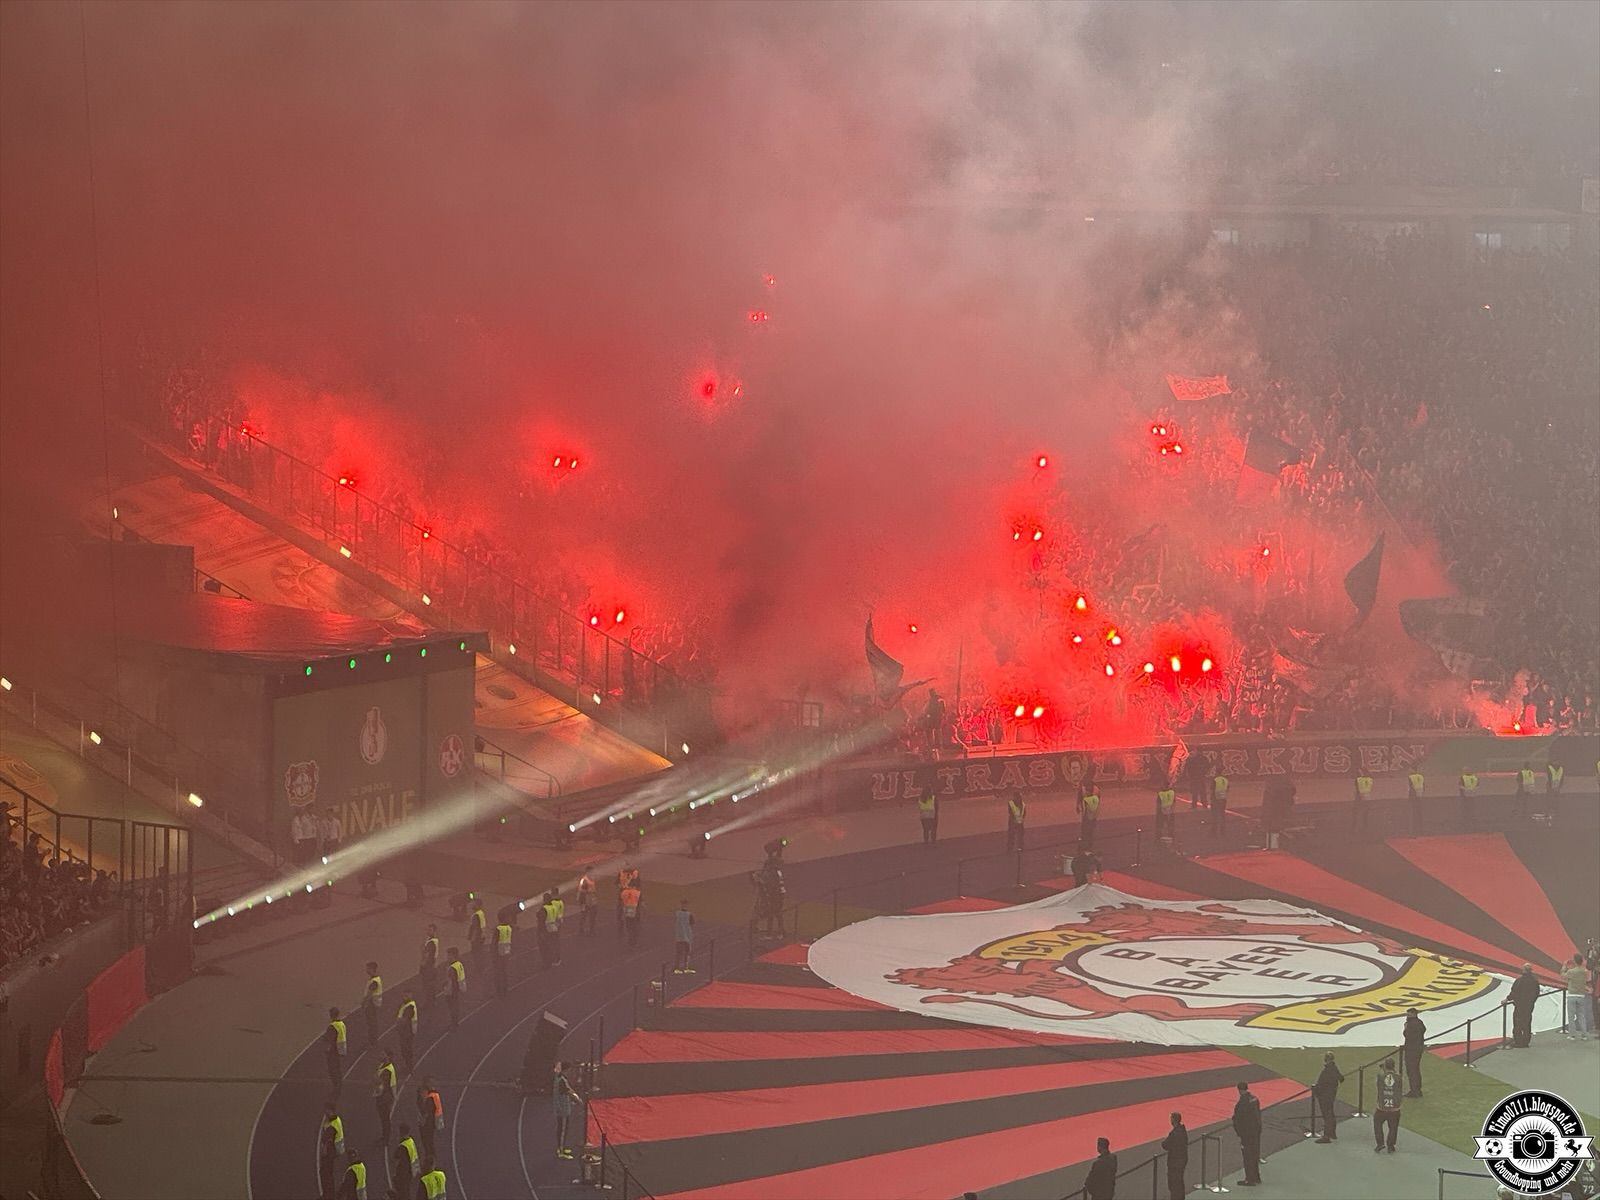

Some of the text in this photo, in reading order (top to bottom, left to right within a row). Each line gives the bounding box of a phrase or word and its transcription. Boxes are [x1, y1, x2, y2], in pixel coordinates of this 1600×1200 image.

[872, 761, 1054, 799] ULTRAS
[334, 791, 415, 836] INALE
[1001, 933, 1097, 957] 1904
[1152, 944, 1306, 989] BAYER
